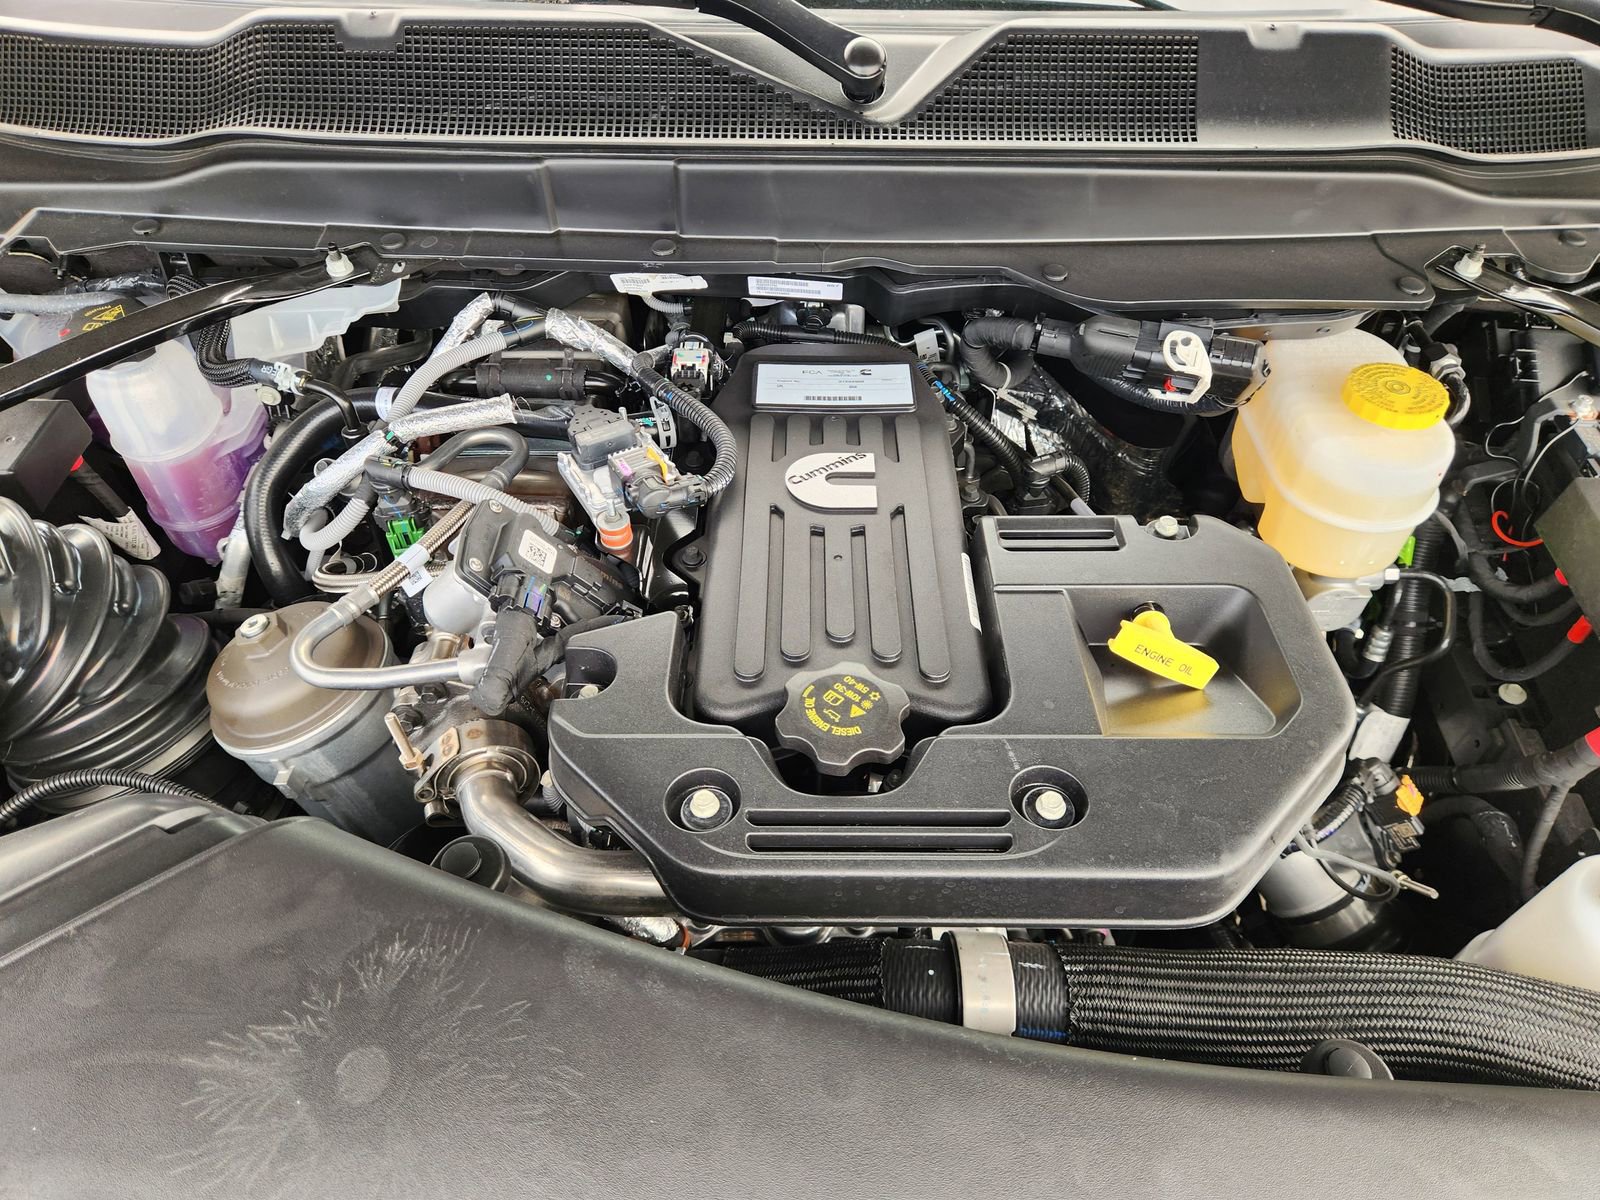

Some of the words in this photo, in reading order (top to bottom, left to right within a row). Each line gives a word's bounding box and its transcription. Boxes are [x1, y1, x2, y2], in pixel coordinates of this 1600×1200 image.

[787, 452, 867, 485] Cummins
[1134, 644, 1174, 667] ENGINE
[1178, 663, 1193, 676] OIL
[843, 675, 870, 694] 5W-40
[805, 708, 831, 732] ENGINE
[831, 725, 862, 736] DIESEL
